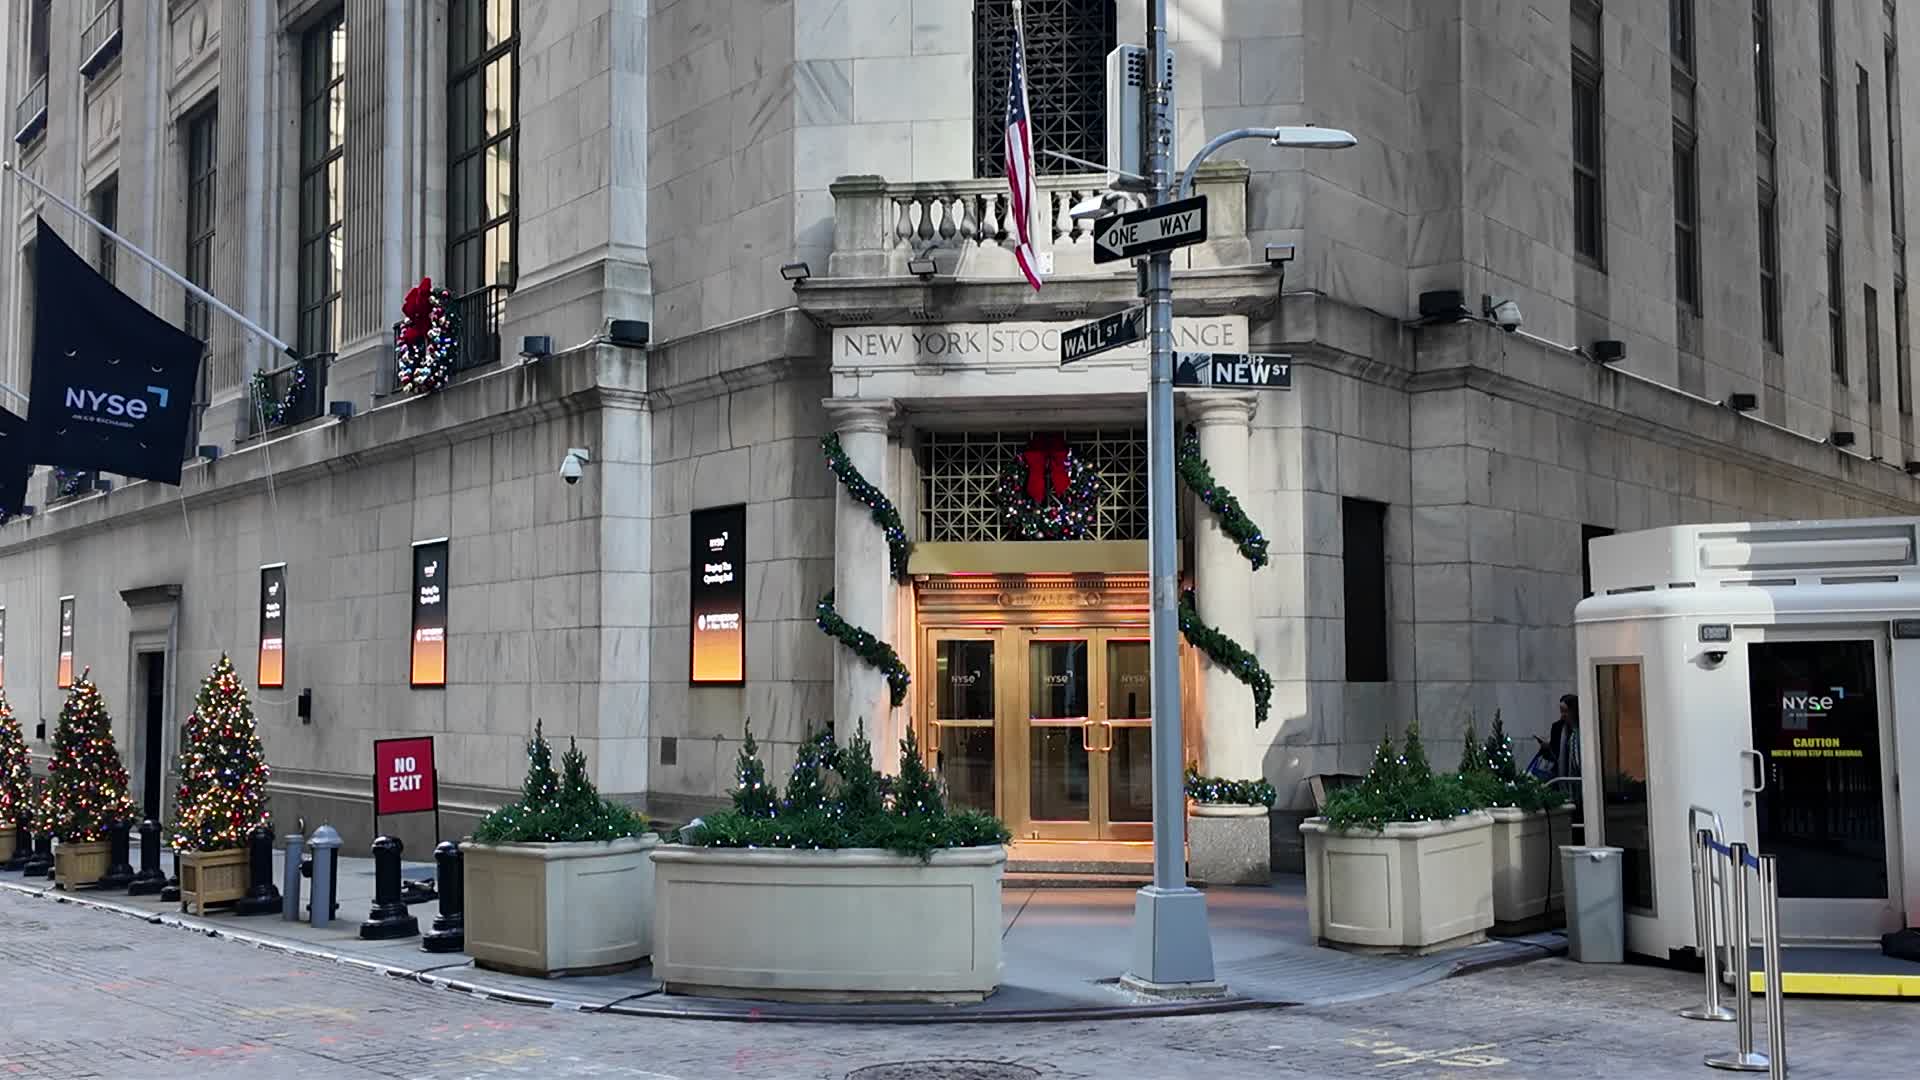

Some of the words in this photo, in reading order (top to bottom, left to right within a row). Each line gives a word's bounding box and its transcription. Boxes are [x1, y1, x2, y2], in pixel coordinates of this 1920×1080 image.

[1108, 225, 1138, 247] ONE
[1159, 213, 1193, 236] WAY
[844, 333, 903, 357] NEW
[912, 331, 981, 354] YORK
[991, 328, 1058, 352] STOC
[1064, 329, 1106, 357] WALL
[1106, 323, 1118, 337] ST
[1216, 363, 1271, 384] NEW
[1272, 365, 1288, 375] ST
[1793, 738, 1840, 748] CAUTION
[394, 756, 416, 773] NO
[389, 774, 423, 792] EXIT
